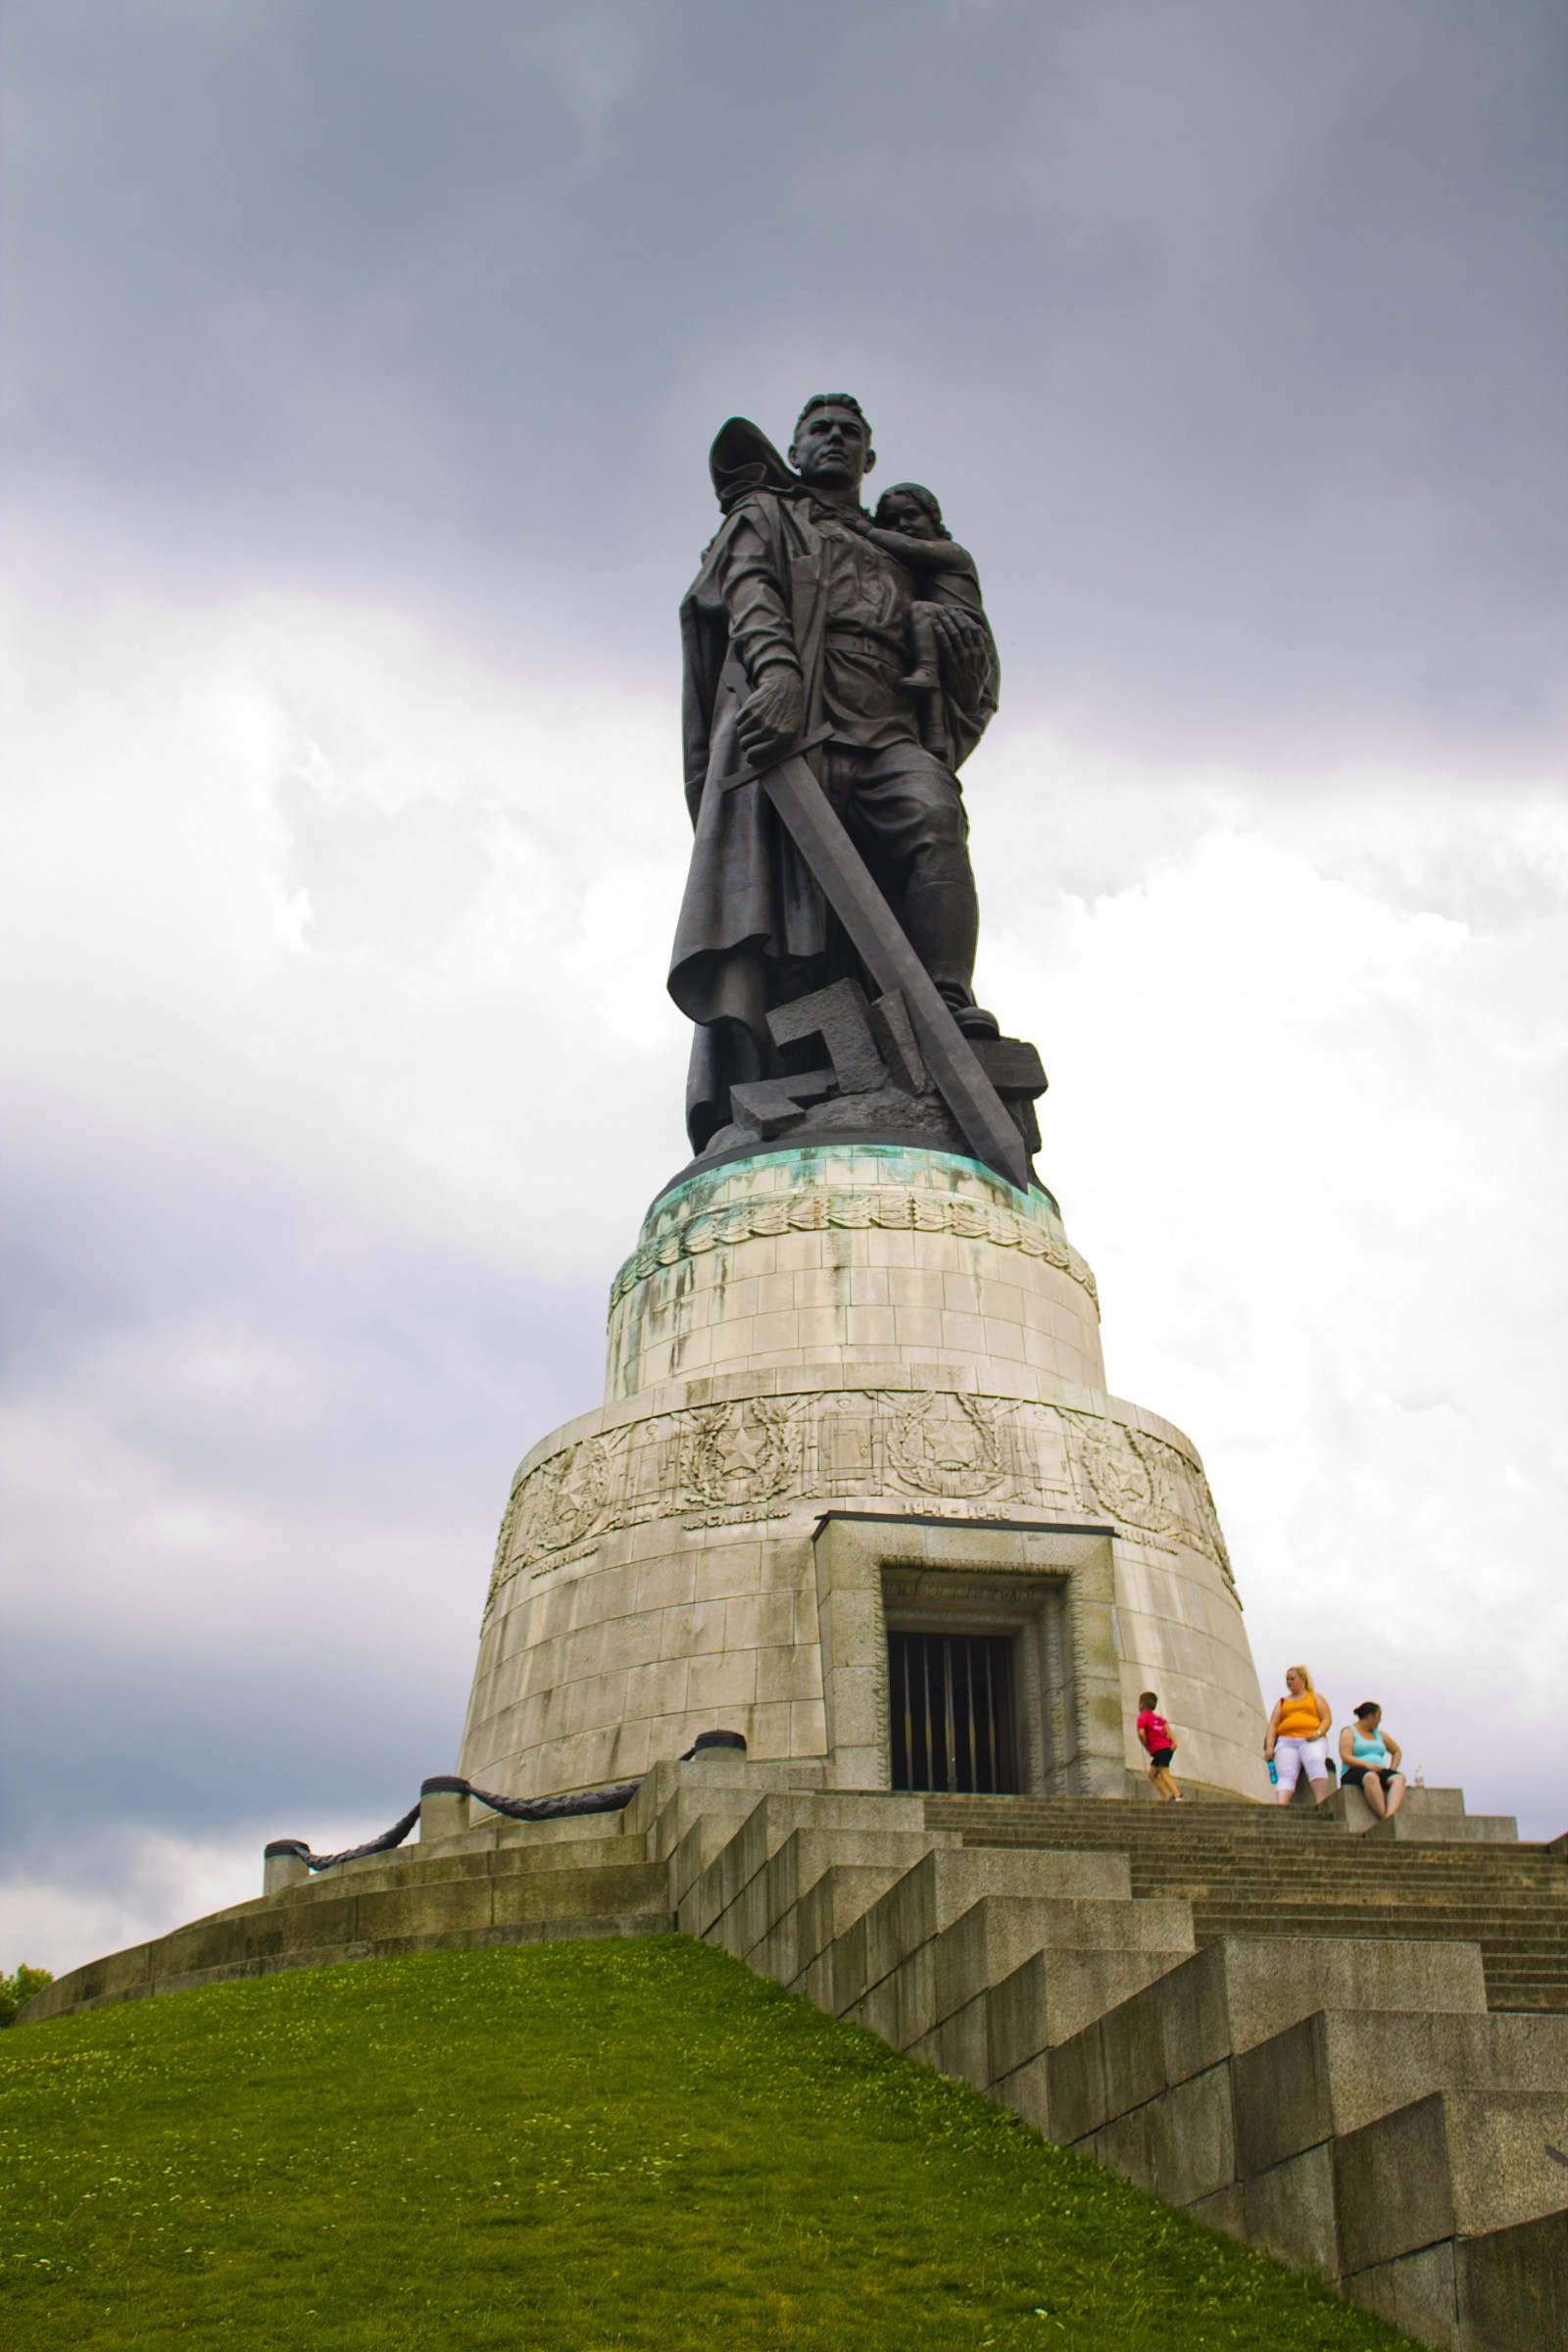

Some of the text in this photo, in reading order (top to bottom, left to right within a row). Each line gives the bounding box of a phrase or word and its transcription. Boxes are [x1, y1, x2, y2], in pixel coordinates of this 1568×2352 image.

[706, 1506, 768, 1528] СЛАВА
[902, 1501, 945, 1517] 1941
[966, 1504, 1011, 1521] 1945
